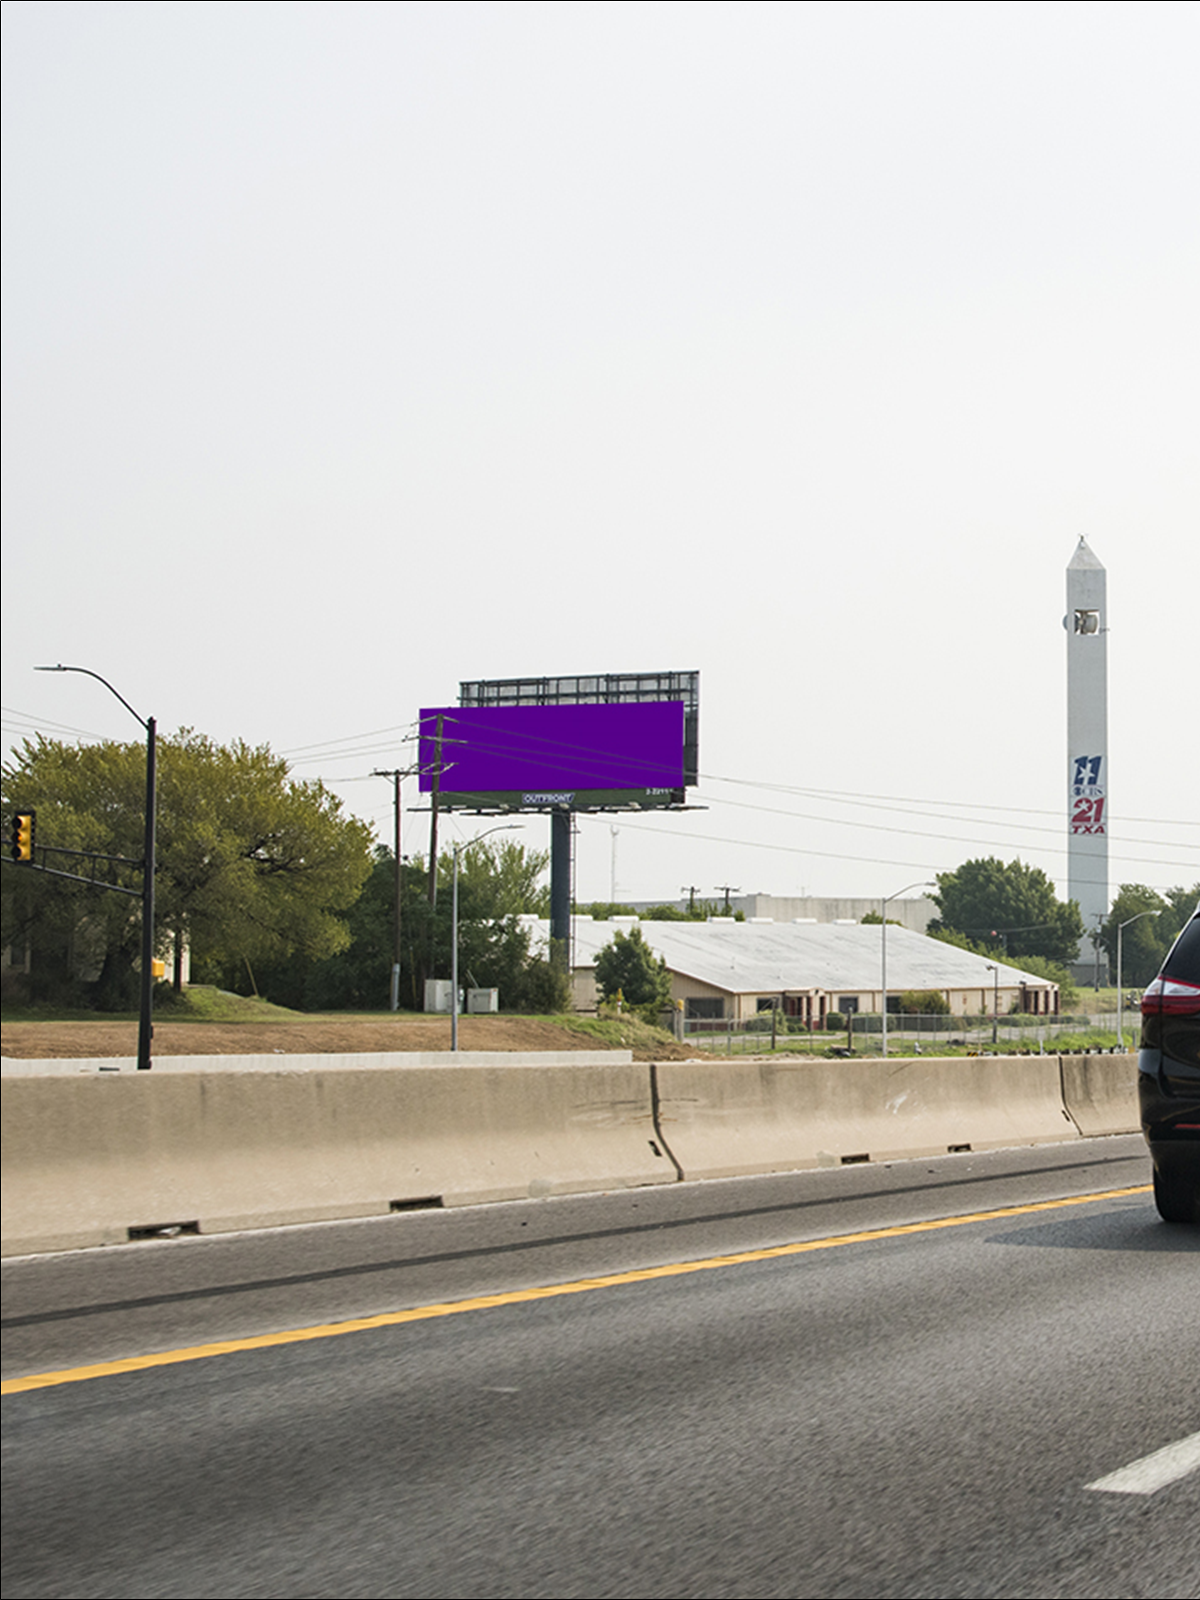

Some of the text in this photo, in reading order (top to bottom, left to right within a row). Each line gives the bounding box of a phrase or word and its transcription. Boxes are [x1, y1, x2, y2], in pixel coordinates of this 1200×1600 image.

[1074, 755, 1102, 786] 11
[523, 793, 574, 803] OUTFRONT
[1071, 797, 1105, 823] 21
[1072, 825, 1105, 834] TXA
